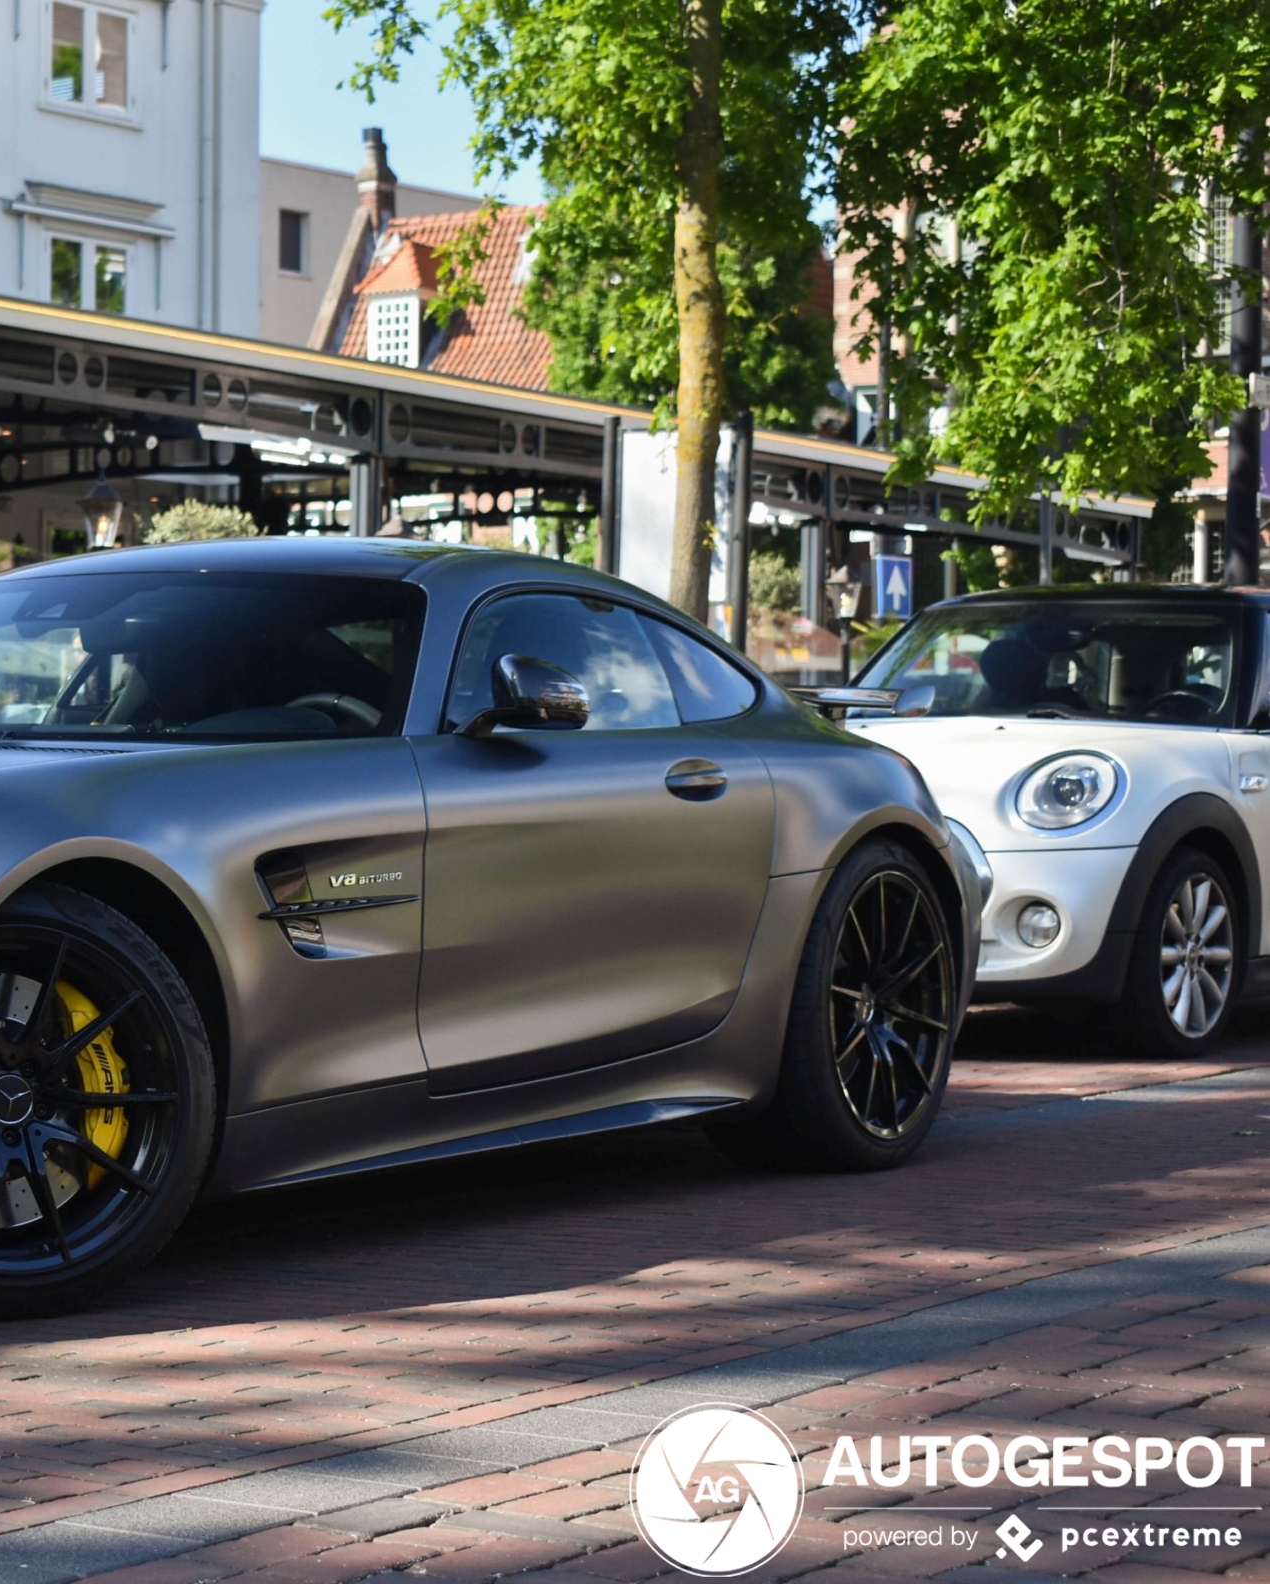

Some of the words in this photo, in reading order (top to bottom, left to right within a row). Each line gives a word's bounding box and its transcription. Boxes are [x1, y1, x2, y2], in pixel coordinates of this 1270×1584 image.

[329, 873, 357, 888] V8
[358, 871, 403, 885] BITURBO
[107, 920, 188, 1005] ZERO
